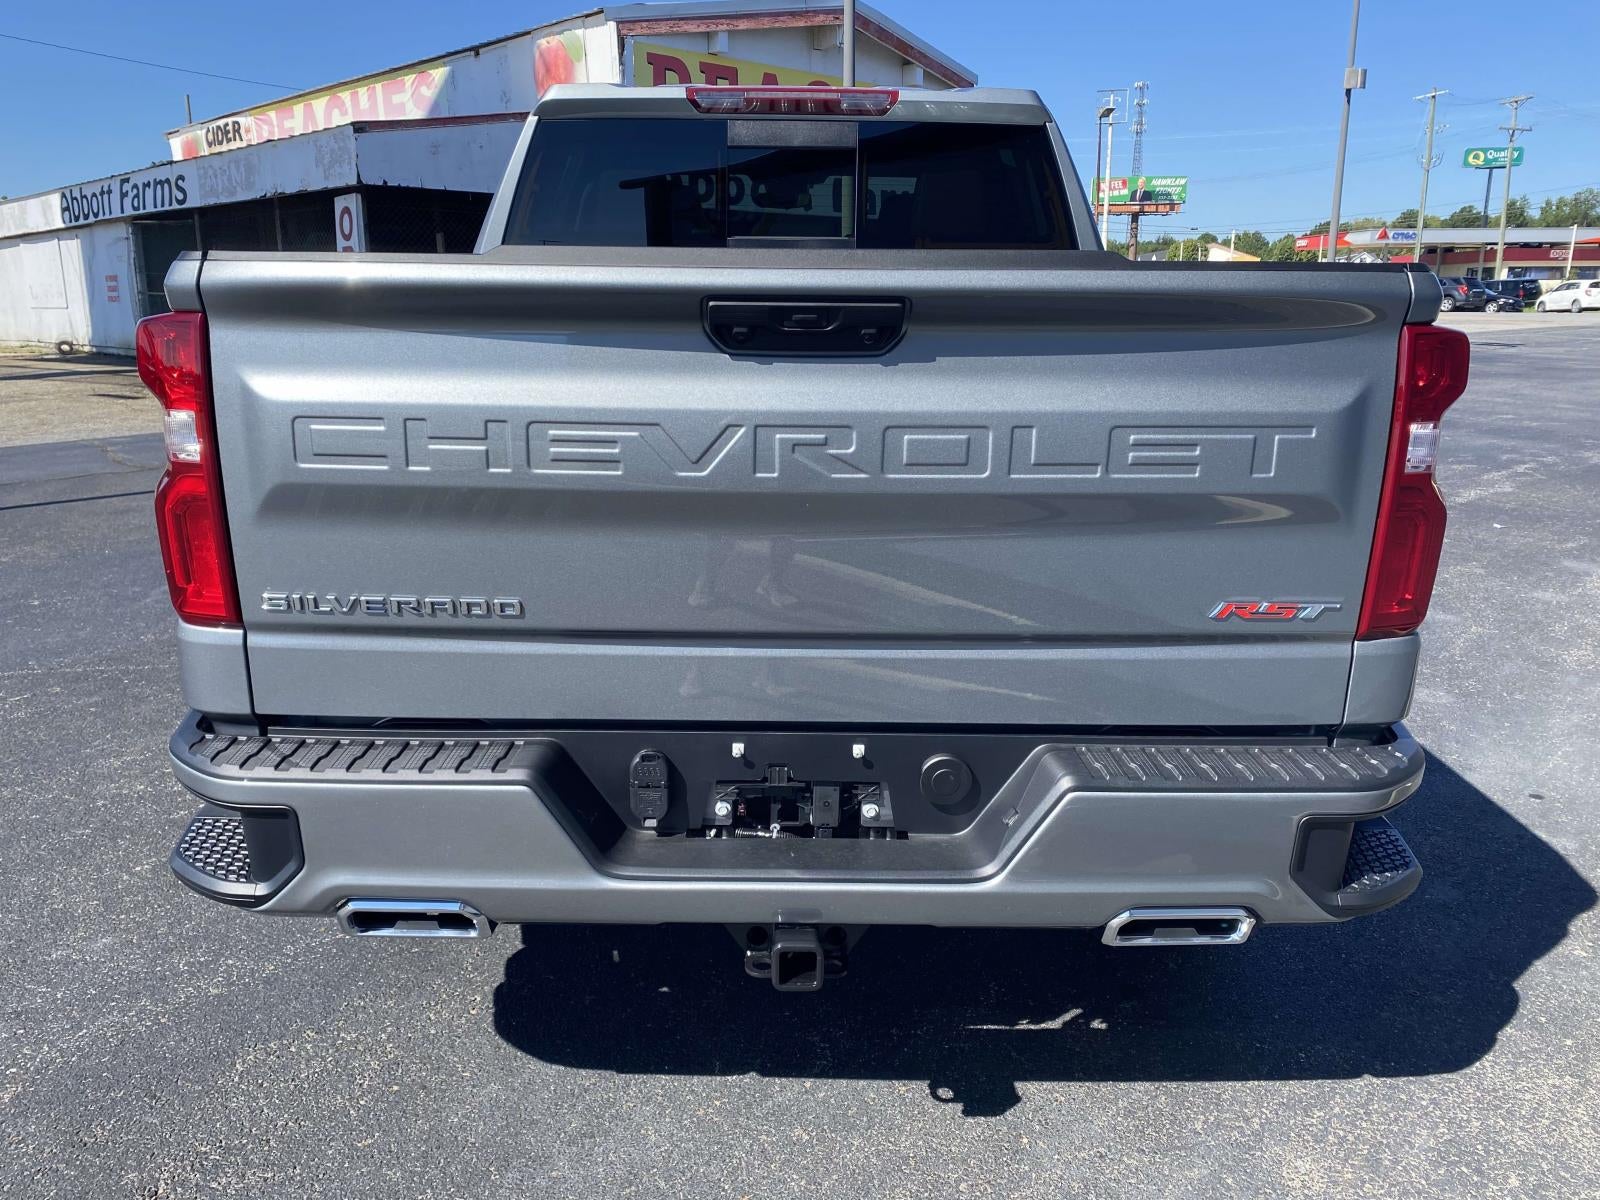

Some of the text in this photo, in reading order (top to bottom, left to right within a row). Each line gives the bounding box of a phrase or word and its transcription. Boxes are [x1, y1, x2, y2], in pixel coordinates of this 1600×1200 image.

[205, 120, 243, 148] CIDER
[1487, 150, 1520, 159] Qualy
[1151, 178, 1188, 186] HAWKLAW
[60, 184, 113, 223] Abbott
[119, 174, 188, 214] Farms
[292, 416, 1317, 478] CHEVROLET
[261, 592, 524, 617] SILVERADO
[1208, 601, 1342, 619] RST
